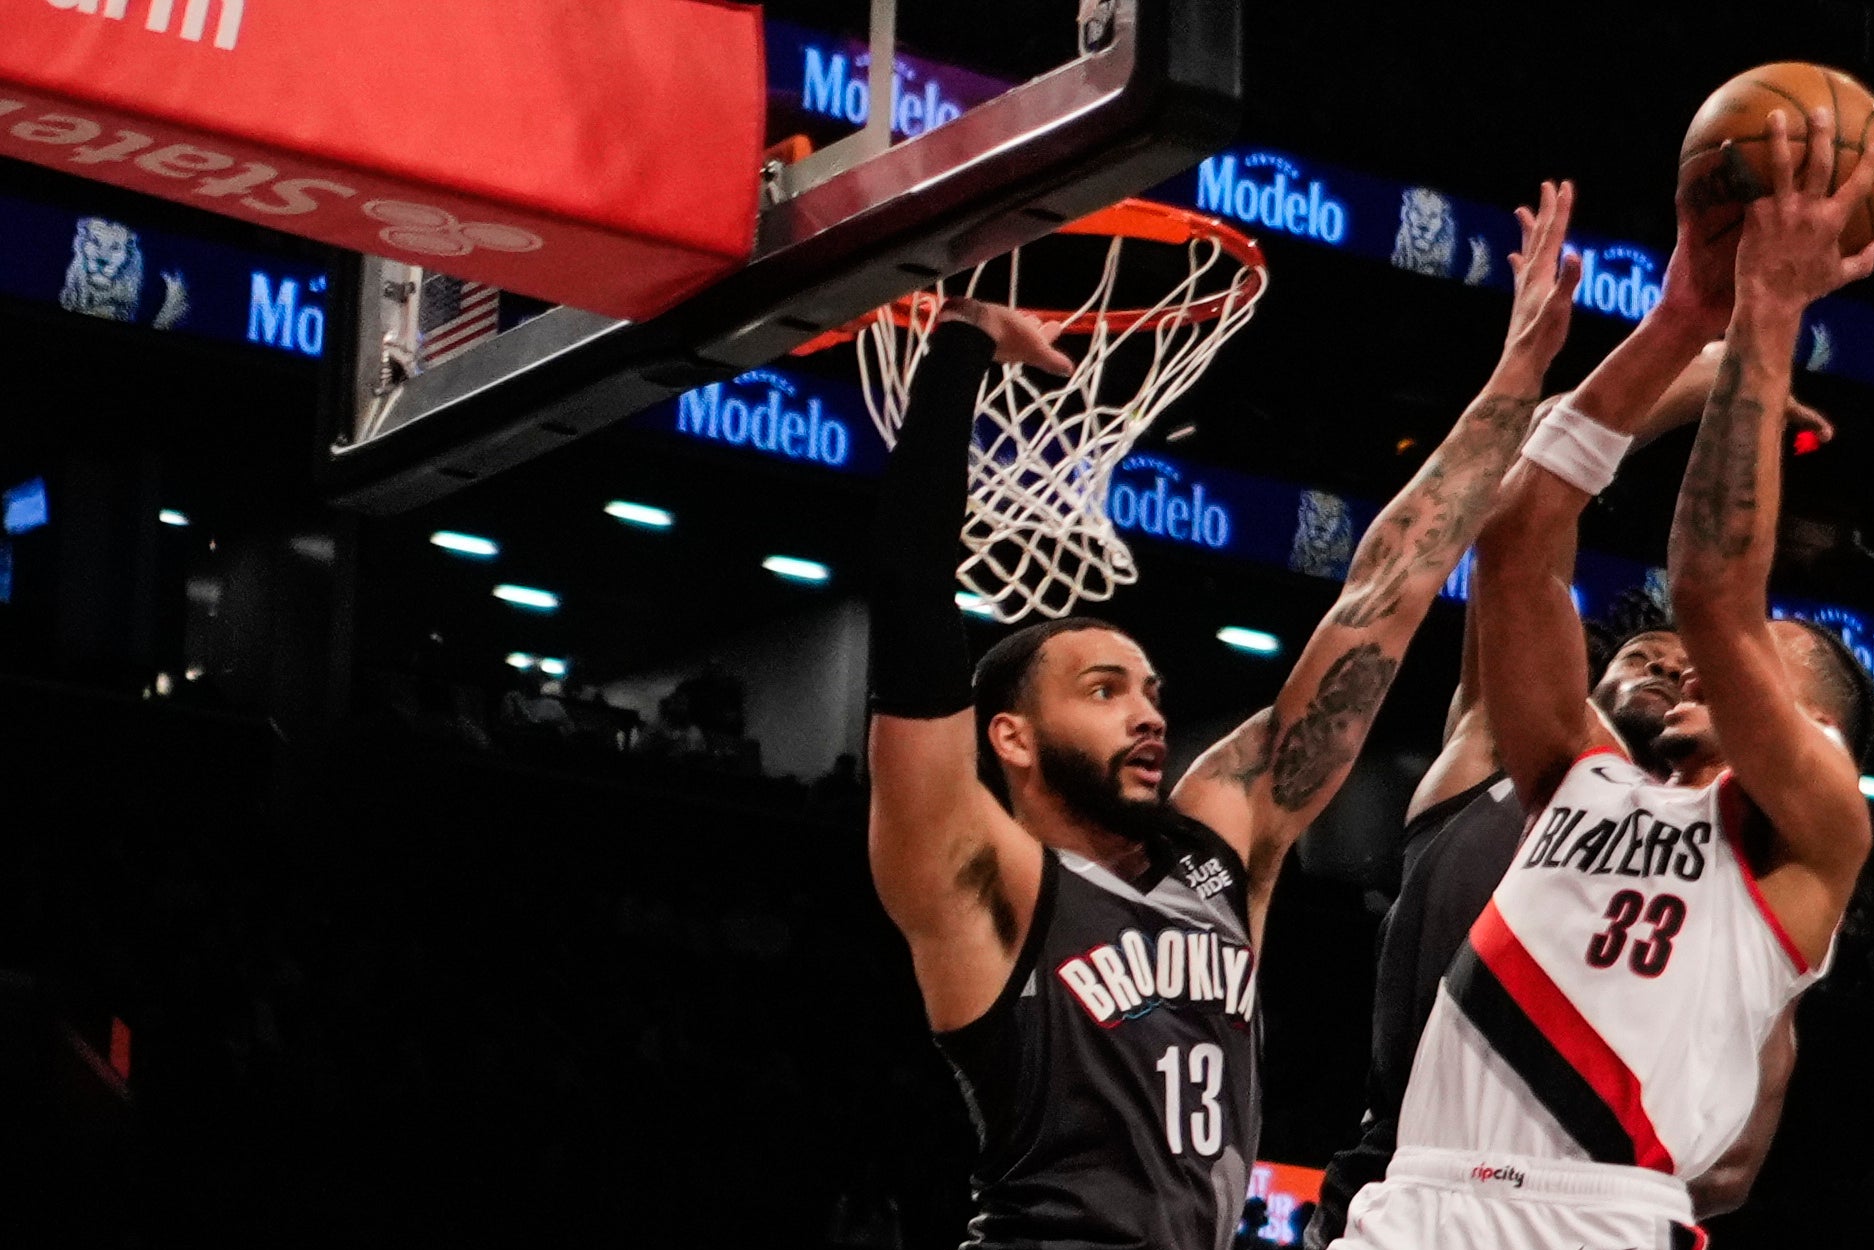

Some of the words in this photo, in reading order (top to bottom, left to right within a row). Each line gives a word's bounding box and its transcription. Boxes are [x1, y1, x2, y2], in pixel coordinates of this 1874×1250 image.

[1197, 155, 1344, 243] Modelo
[678, 382, 848, 465] Modelo
[1112, 476, 1228, 547] odelo
[1523, 807, 1712, 882] BLAZERS
[1584, 889, 1687, 979] 33
[1156, 1042, 1225, 1158] 13
